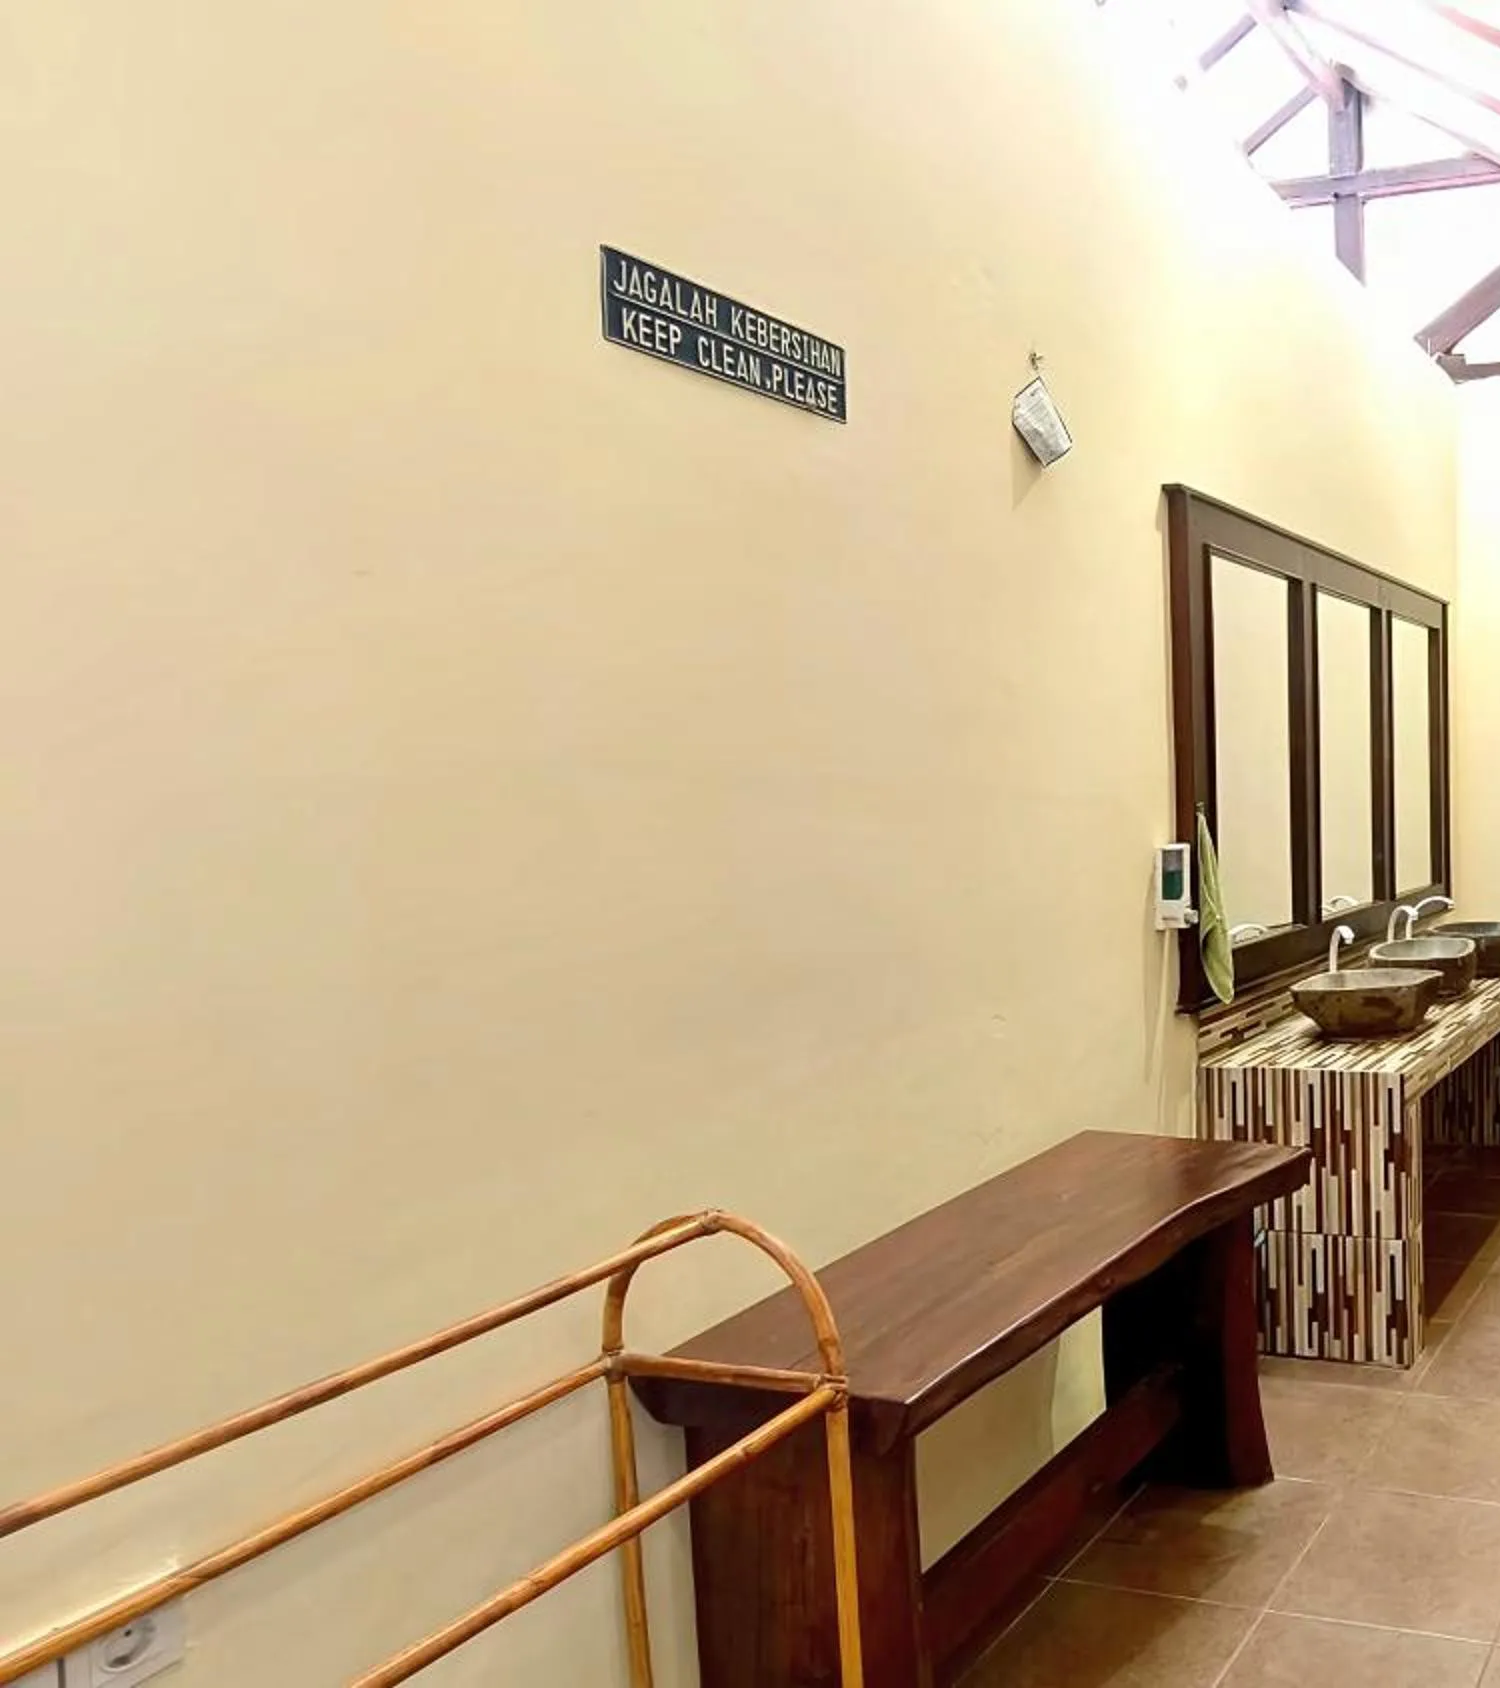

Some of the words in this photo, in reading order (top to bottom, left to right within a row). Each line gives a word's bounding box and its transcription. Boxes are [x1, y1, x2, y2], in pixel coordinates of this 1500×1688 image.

[613, 260, 717, 328] JAGALAH
[730, 306, 841, 376] KEBERSIHAN
[622, 307, 682, 356] KEEP
